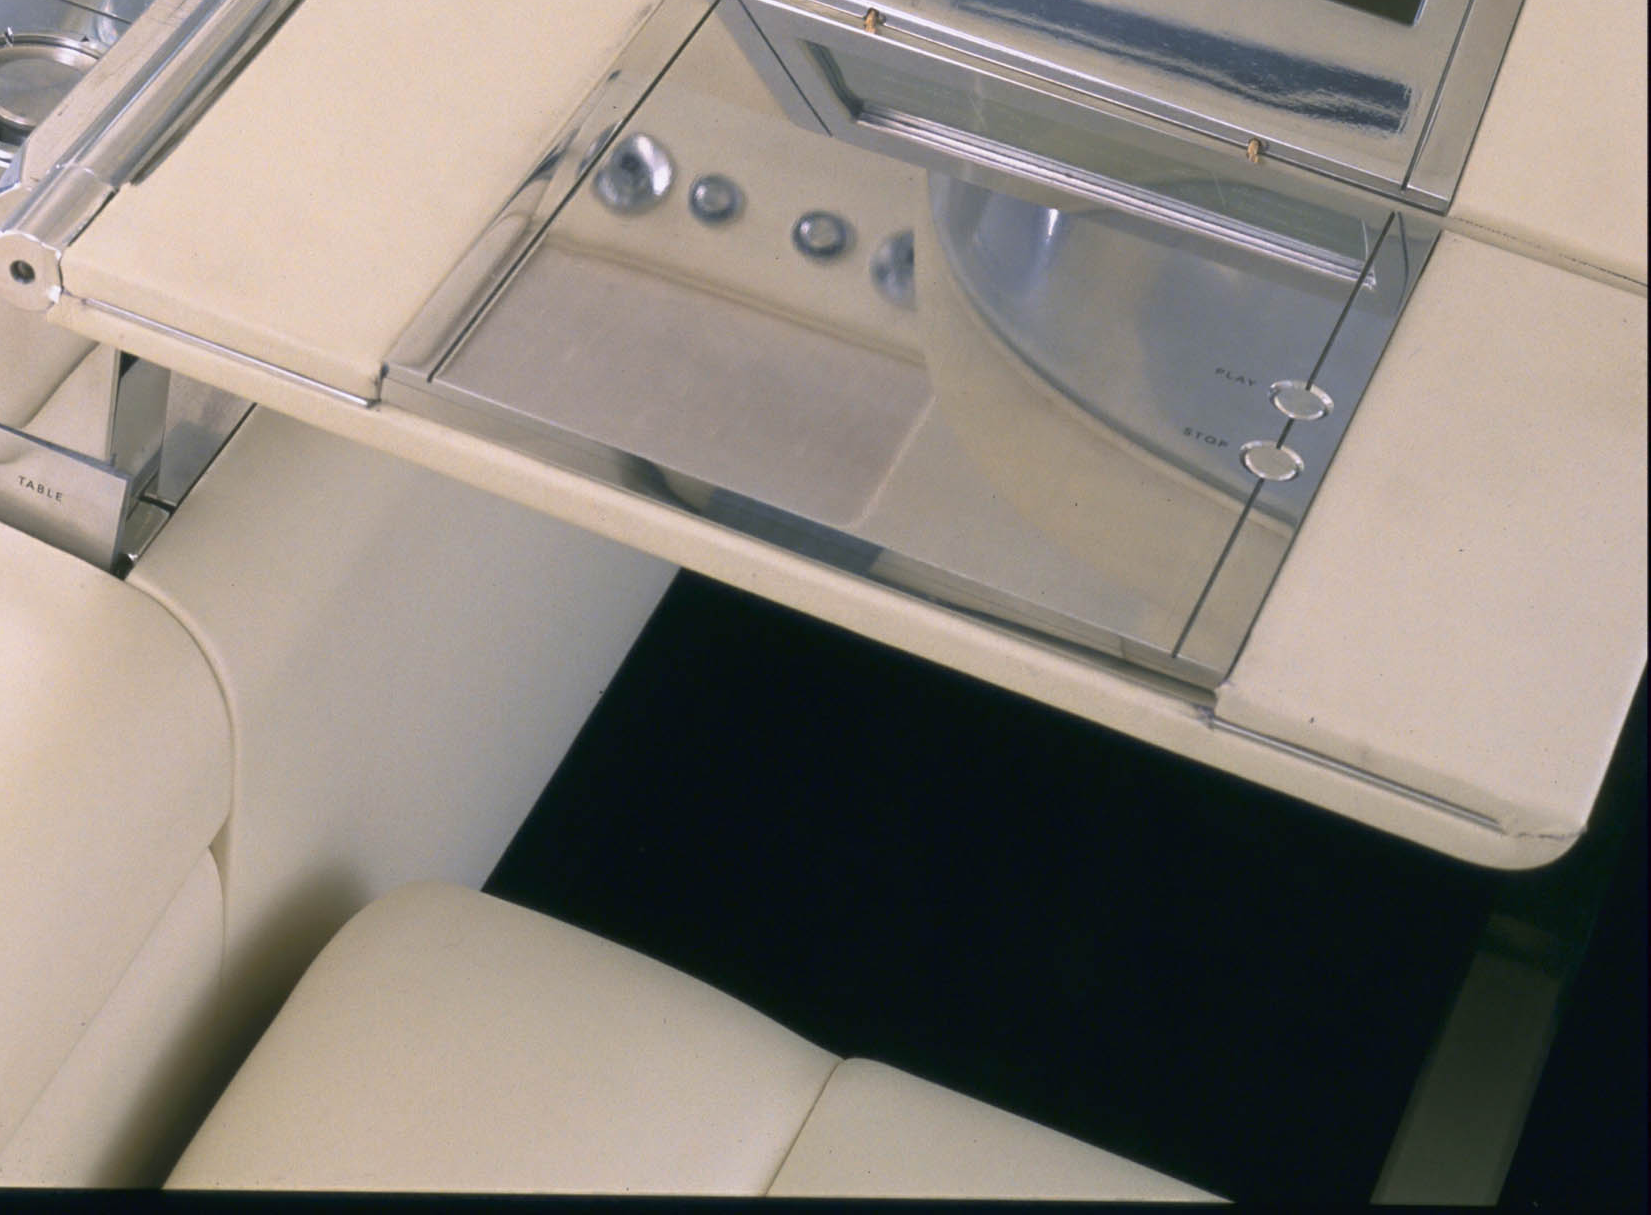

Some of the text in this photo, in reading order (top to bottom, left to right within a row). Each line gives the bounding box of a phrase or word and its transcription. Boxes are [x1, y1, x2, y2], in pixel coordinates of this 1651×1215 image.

[1215, 367, 1258, 387] PLAY
[1183, 426, 1230, 448] STOP
[17, 474, 63, 503] TABLE
